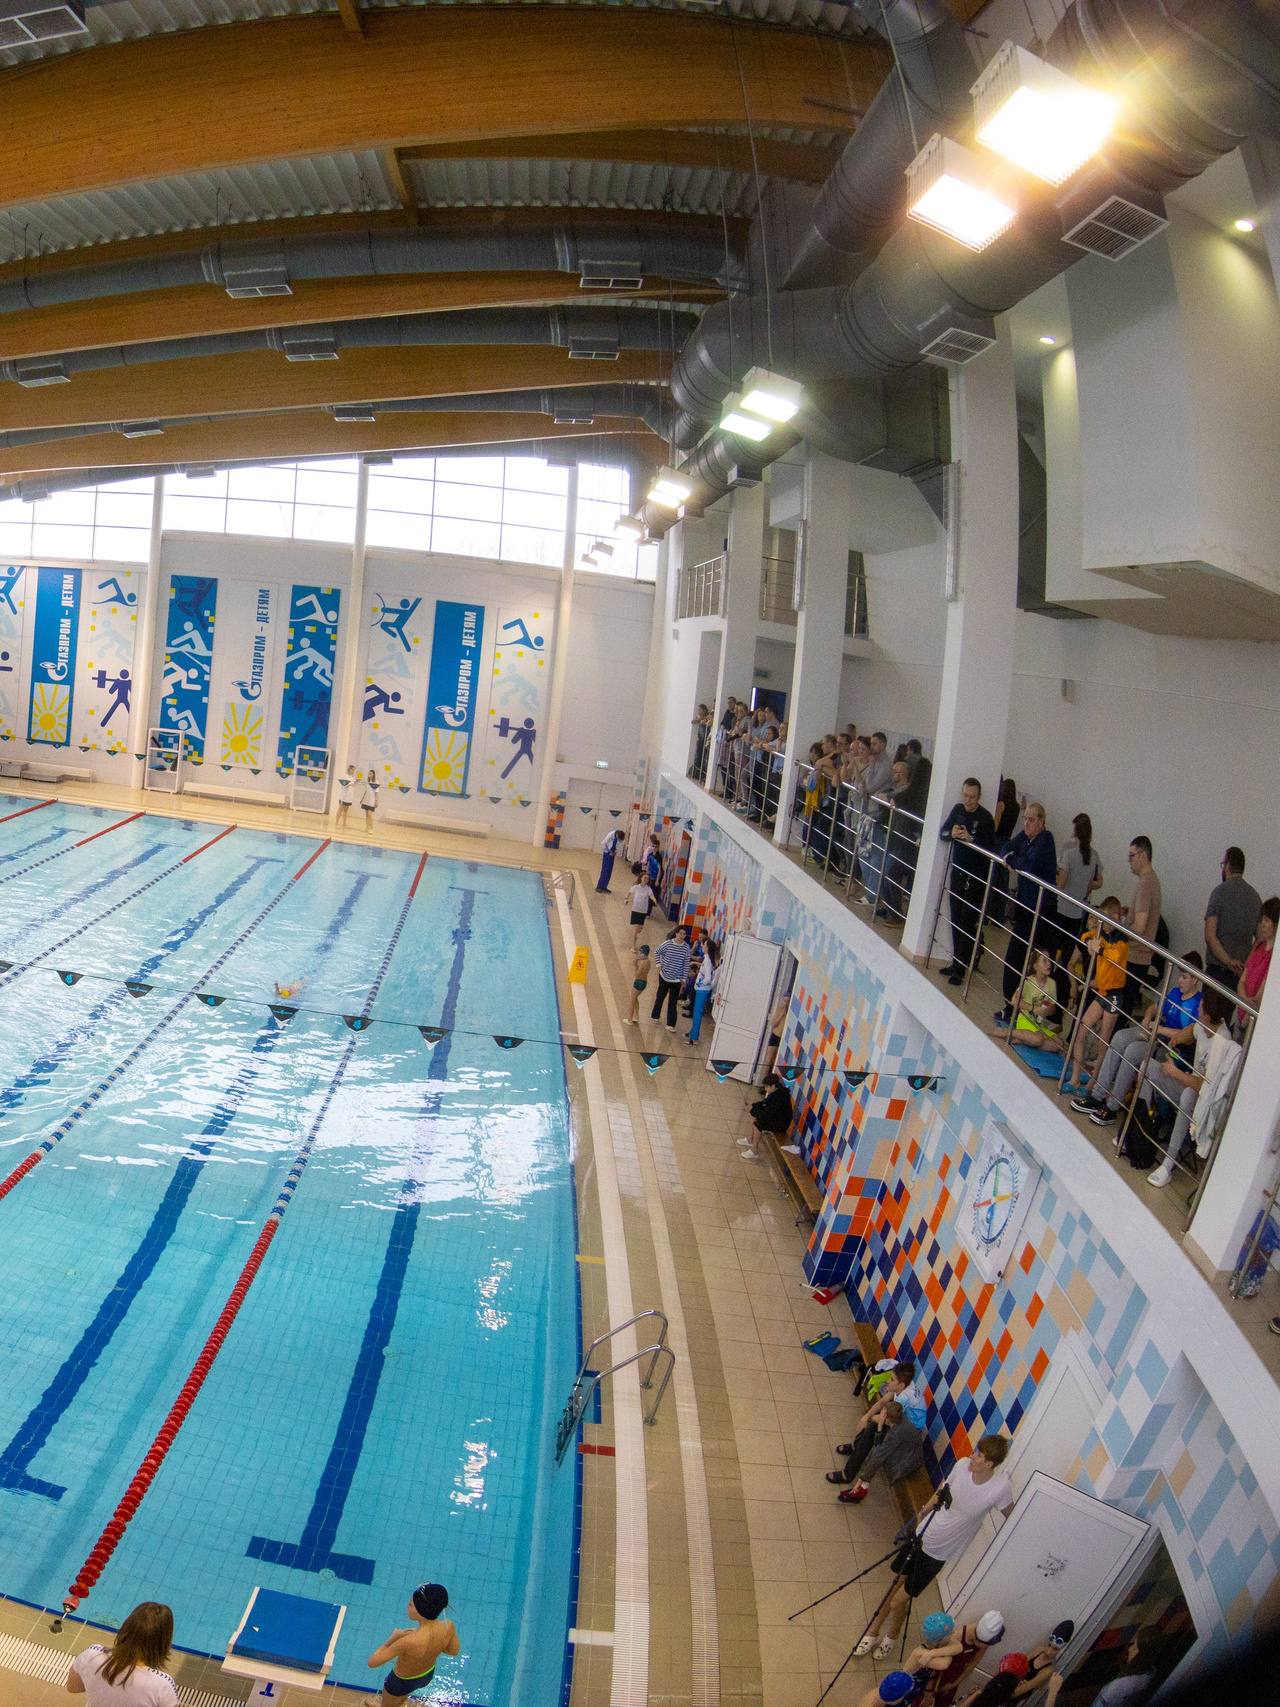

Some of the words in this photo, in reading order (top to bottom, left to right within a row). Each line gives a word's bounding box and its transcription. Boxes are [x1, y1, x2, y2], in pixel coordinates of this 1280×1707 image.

[61, 574, 75, 608] ДЕТЯМ
[256, 588, 271, 624] ДЕТЯМ
[57, 618, 71, 663] ГАЗПРОМ
[461, 611, 477, 648] ДЕТЯМ
[251, 635, 267, 682] ГАЗПРОМ
[455, 659, 473, 708] ГАЗПРОМ
[259, 1682, 275, 1698] 1
